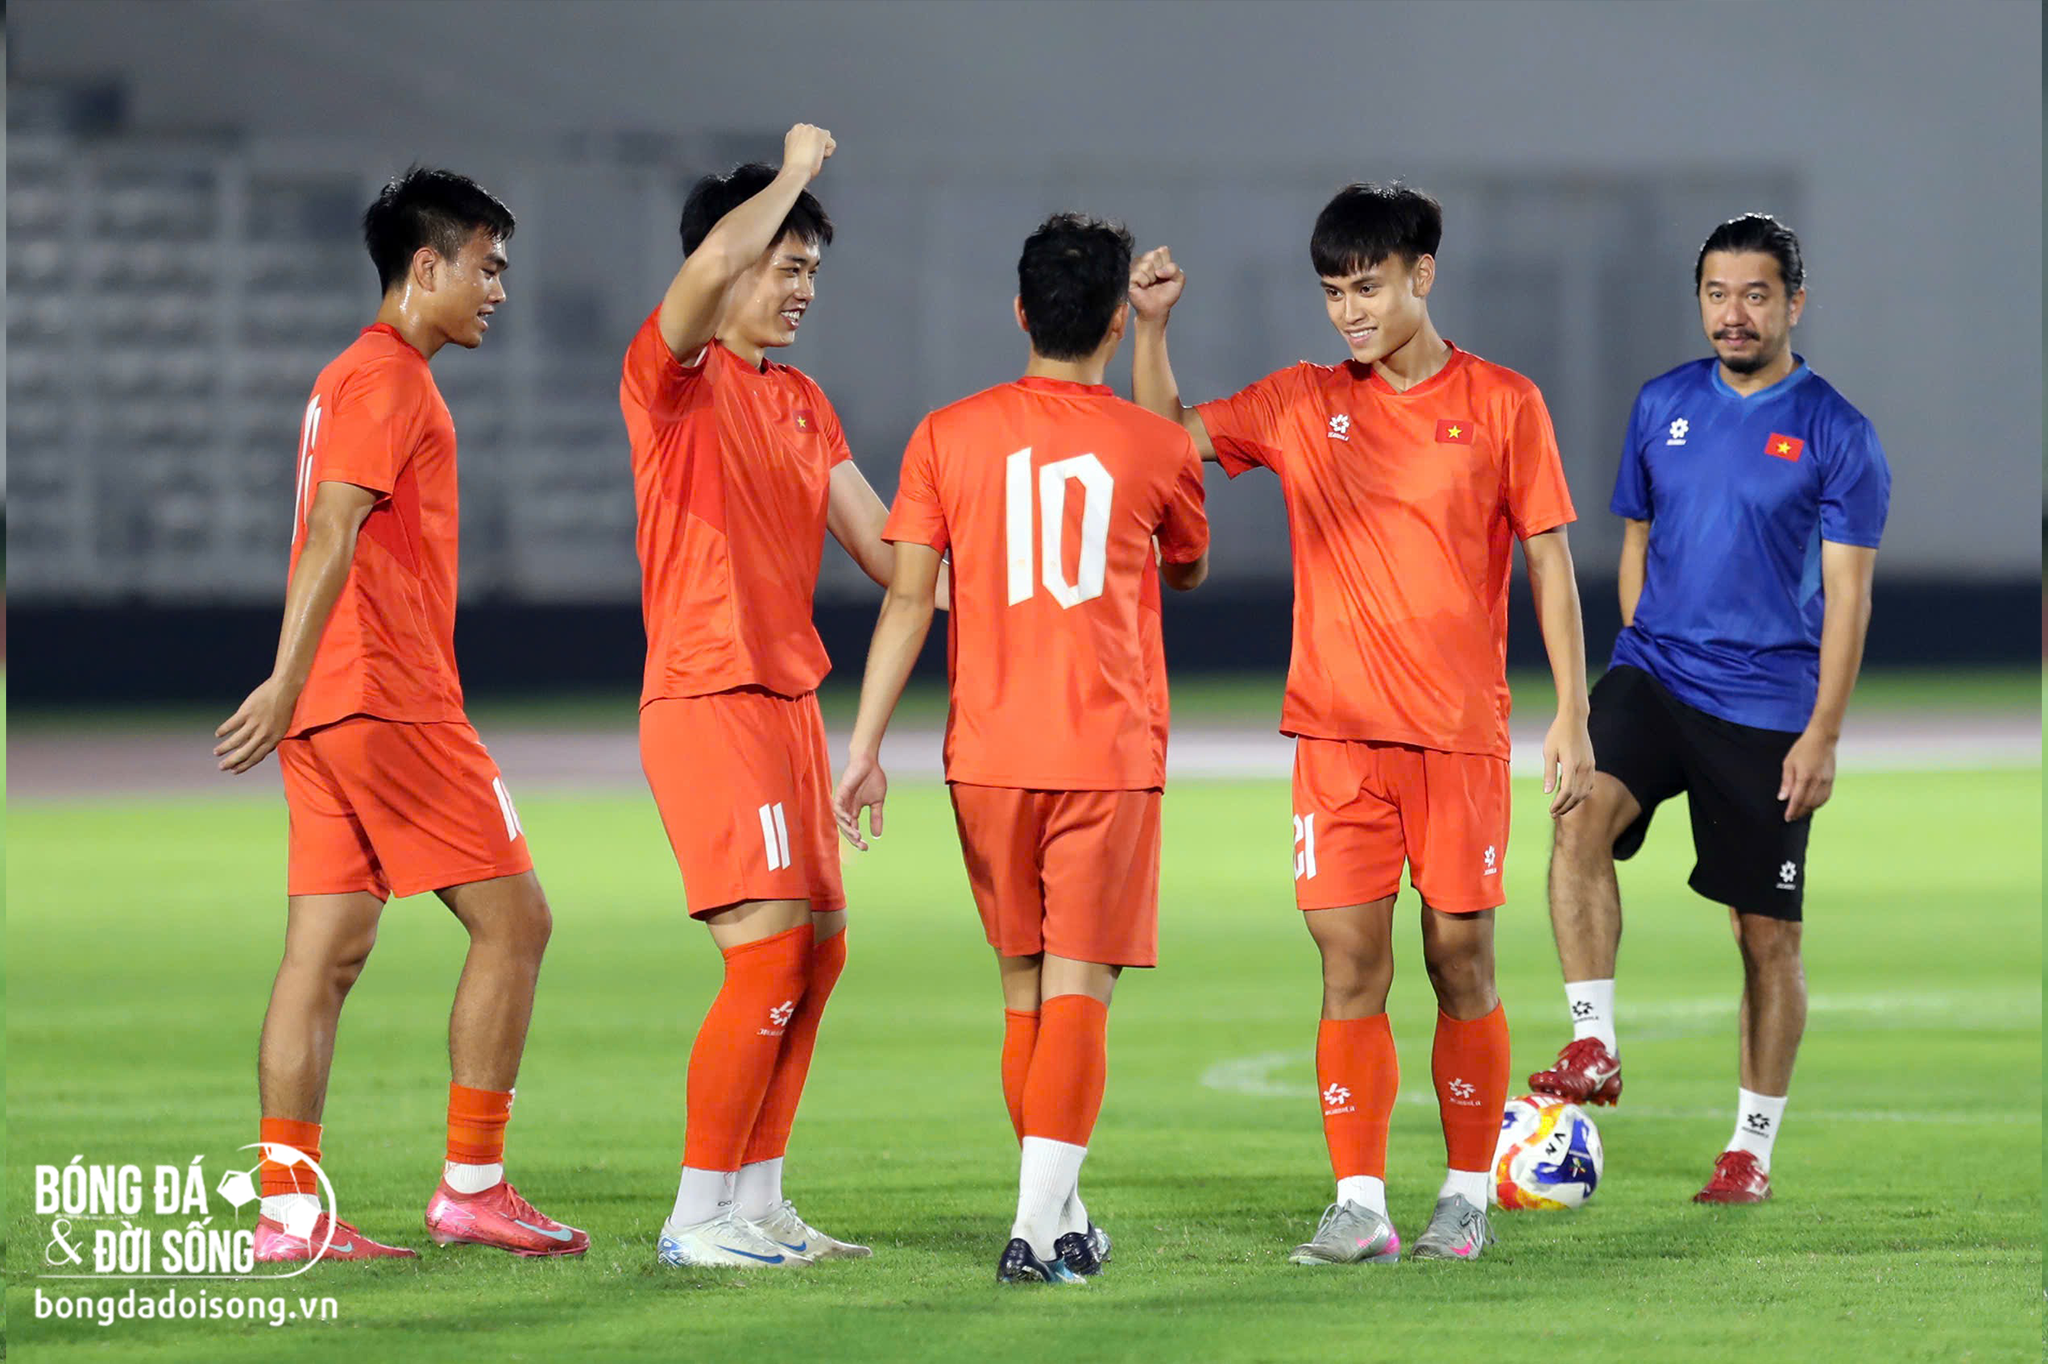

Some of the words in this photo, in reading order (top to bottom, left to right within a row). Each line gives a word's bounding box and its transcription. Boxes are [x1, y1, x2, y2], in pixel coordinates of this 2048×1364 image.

[1006, 447, 1114, 610] 10
[492, 776, 522, 843] 1
[759, 802, 791, 872] 11
[1293, 812, 1317, 881] 21
